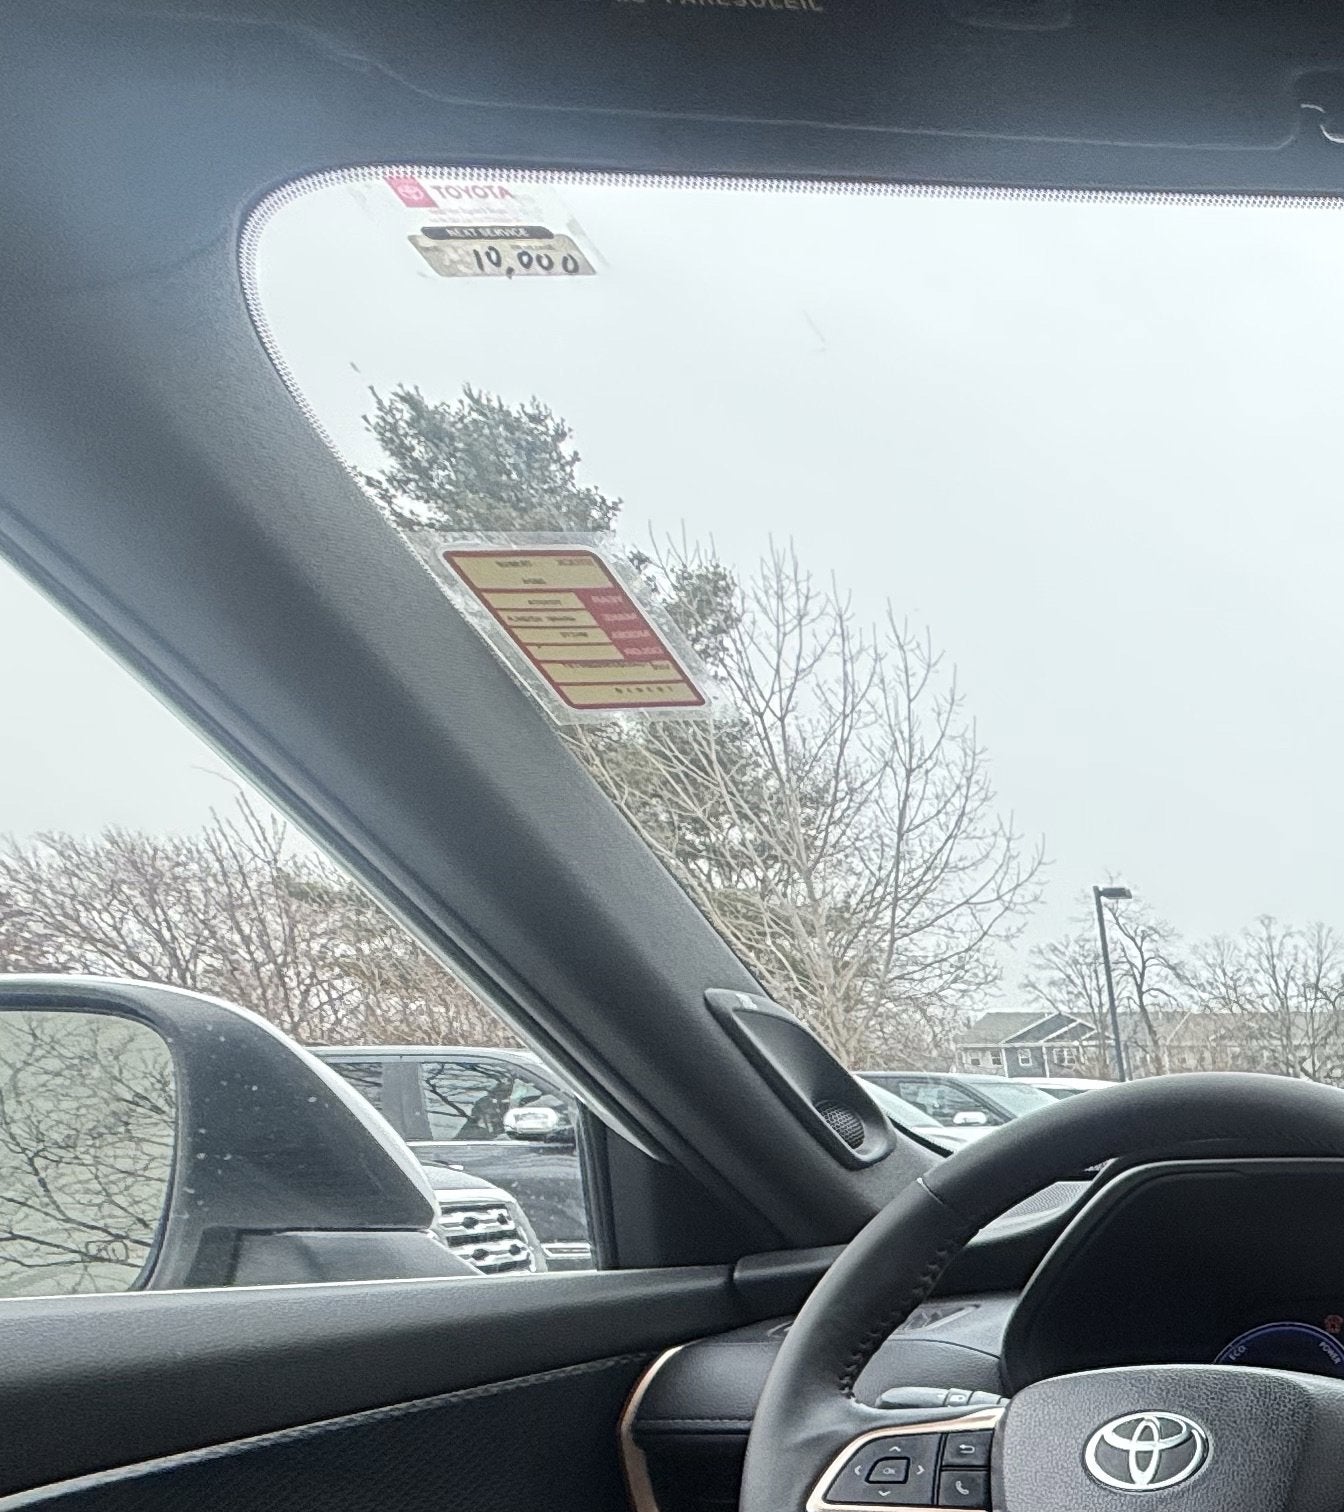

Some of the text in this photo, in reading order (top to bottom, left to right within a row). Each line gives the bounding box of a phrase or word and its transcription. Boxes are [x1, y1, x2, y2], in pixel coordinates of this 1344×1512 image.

[430, 185, 515, 200] TOYOTA
[472, 245, 580, 280] 10,000
[1228, 1344, 1247, 1361] ECO
[1319, 1341, 1343, 1365] POWER
